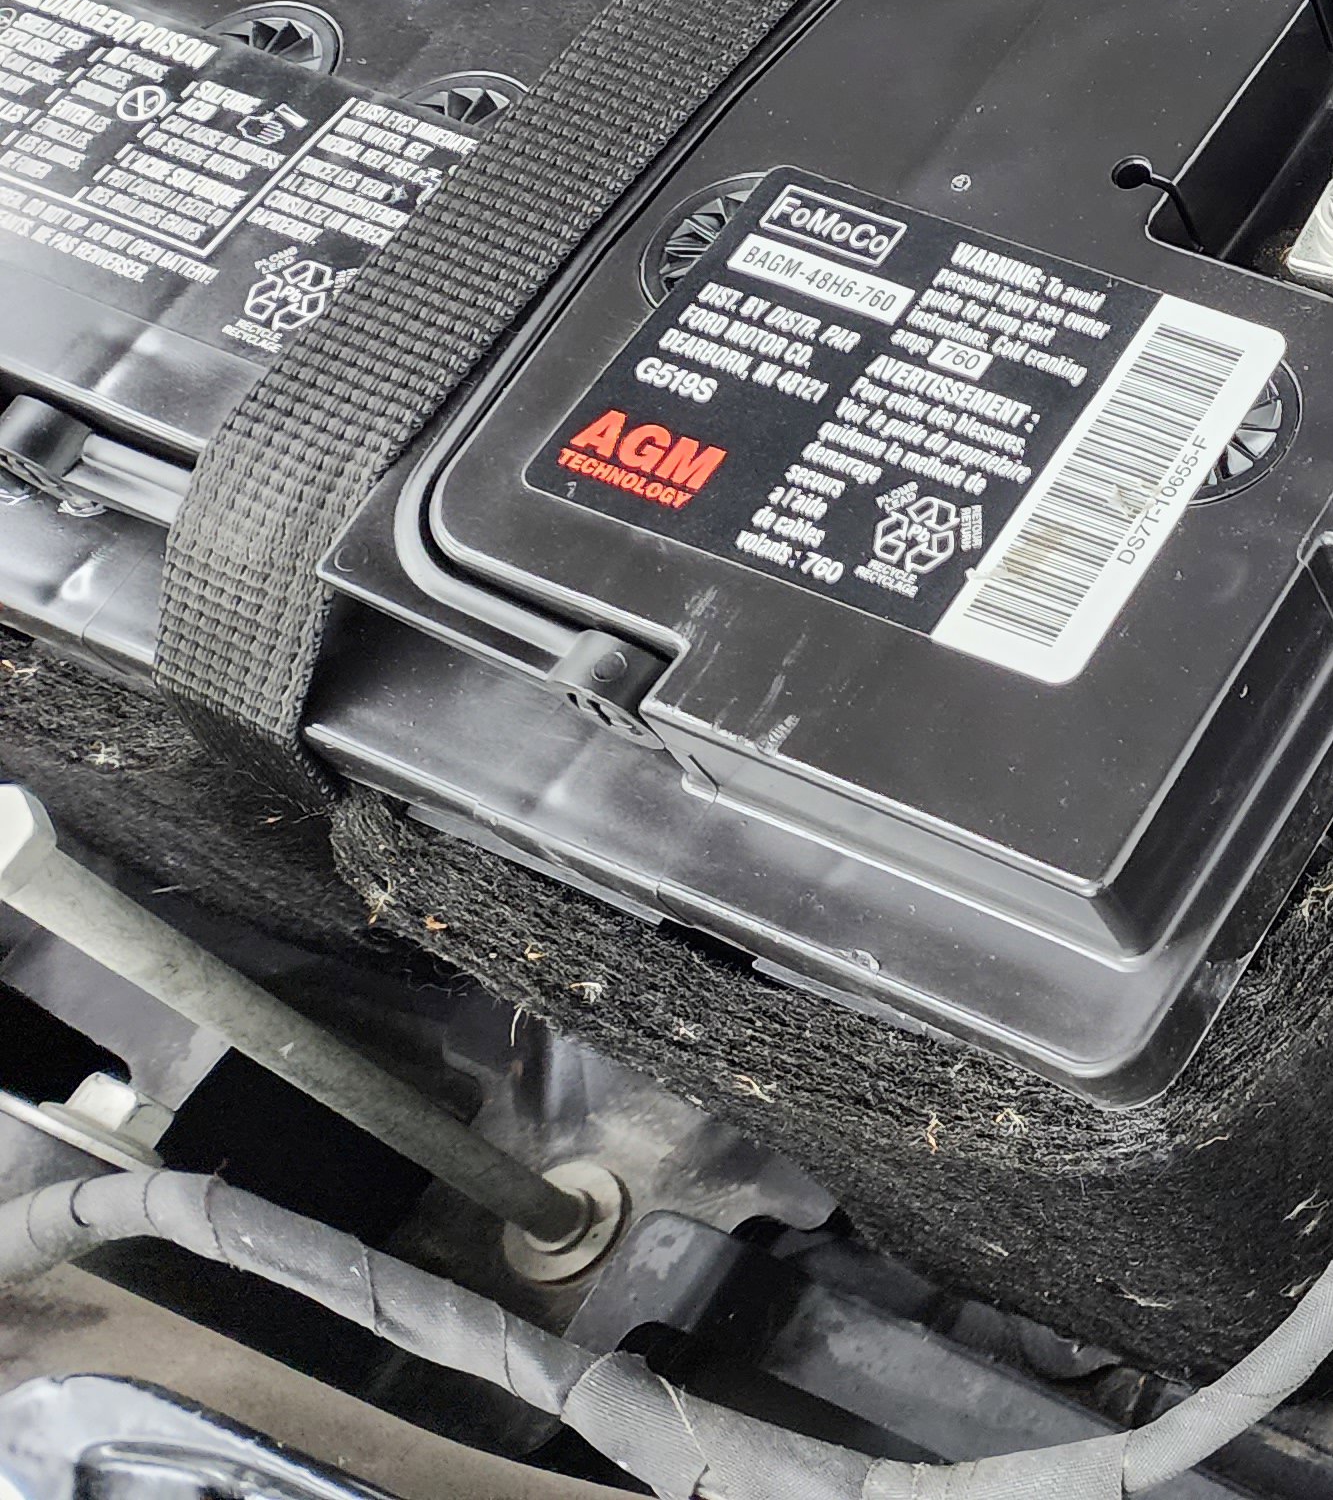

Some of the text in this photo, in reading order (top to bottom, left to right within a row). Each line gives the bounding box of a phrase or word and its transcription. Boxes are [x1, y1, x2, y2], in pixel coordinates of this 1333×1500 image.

[51, 27, 91, 50] EYES
[176, 98, 217, 121] ACID
[383, 112, 418, 133] EYES
[161, 138, 212, 164] SEVERE
[359, 149, 392, 168] HELP
[403, 142, 433, 161] GET
[773, 197, 888, 253] FoMoCo
[158, 251, 218, 283] BATTERY!
[744, 247, 896, 311] BAGM-48H6-760
[952, 243, 1105, 312] WARNING: To avoid
[277, 286, 302, 305] Pb
[917, 289, 1056, 345] guide for jump start
[933, 269, 1110, 339] personal injury see owner
[679, 304, 812, 368] FORD MOTOR CO.
[698, 283, 860, 352] DIST. BY DISTR. PAR
[660, 329, 828, 402] DEARBORN, MI 48121
[891, 329, 980, 369] amps 760
[907, 306, 1087, 386] instructions. Cold cranking
[637, 358, 717, 402] G519S
[867, 356, 1030, 425] AVERTISSEMENT
[850, 376, 889, 404] Pour
[886, 393, 930, 419] eviter
[927, 405, 956, 429] des
[836, 397, 870, 424] Voir
[865, 410, 887, 431] le
[880, 419, 927, 445] guide
[924, 431, 949, 452] du
[573, 412, 723, 488] AGM
[803, 441, 881, 484] demarrage
[884, 442, 903, 465] la
[902, 452, 965, 486] methode
[964, 472, 986, 495] de
[560, 449, 690, 506] TECHNOLOGY
[786, 465, 845, 497] secours
[768, 487, 827, 519] a l'aide
[1117, 435, 1207, 565] DS7T-10655-F
[752, 506, 825, 547] de cables
[904, 524, 933, 546] Pb
[801, 552, 843, 582] 760
[854, 566, 918, 597] RECYCLAGE
[866, 560, 917, 584] RECYCLE
